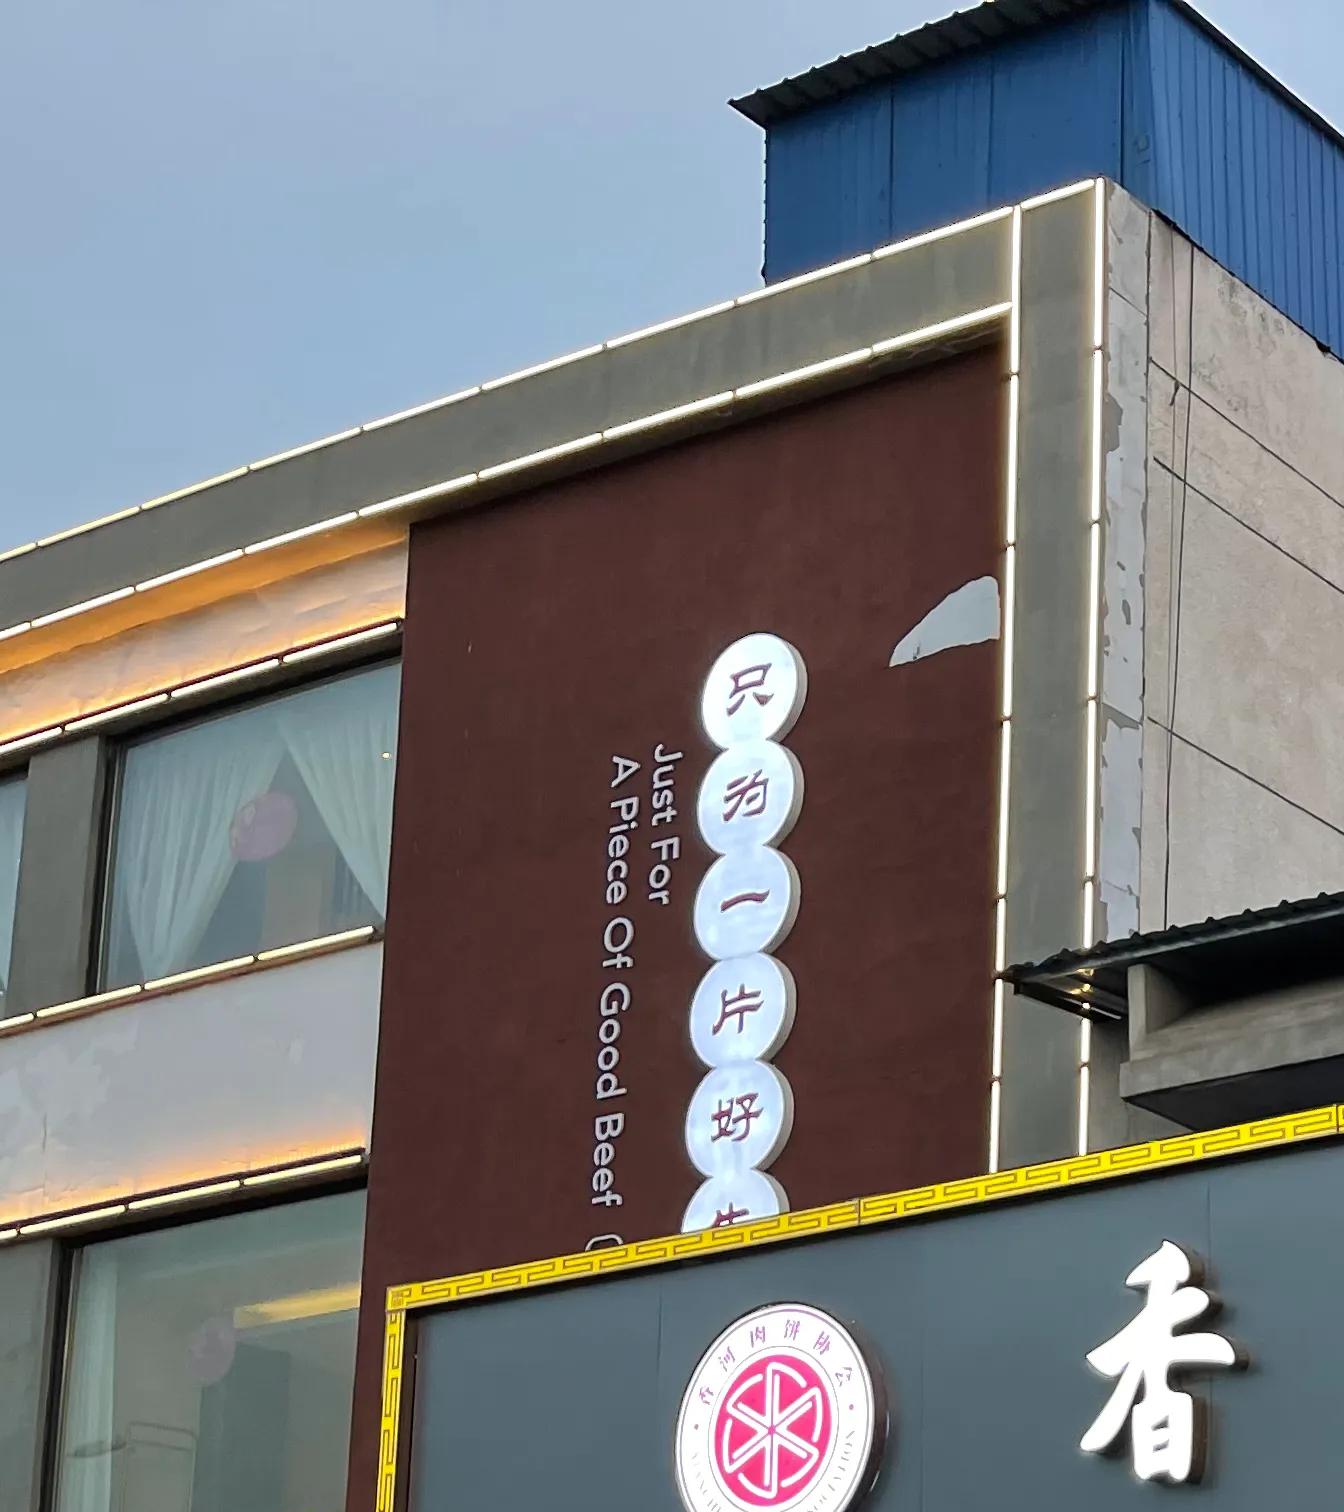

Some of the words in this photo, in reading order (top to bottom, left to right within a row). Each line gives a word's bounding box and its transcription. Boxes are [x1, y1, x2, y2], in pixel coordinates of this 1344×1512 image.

[610, 755, 640, 787] A
[651, 743, 684, 827] Just
[604, 796, 639, 904] Piece
[648, 836, 680, 906] For
[601, 916, 634, 970] Of
[596, 981, 631, 1101] Good
[591, 1111, 625, 1207] Beef
